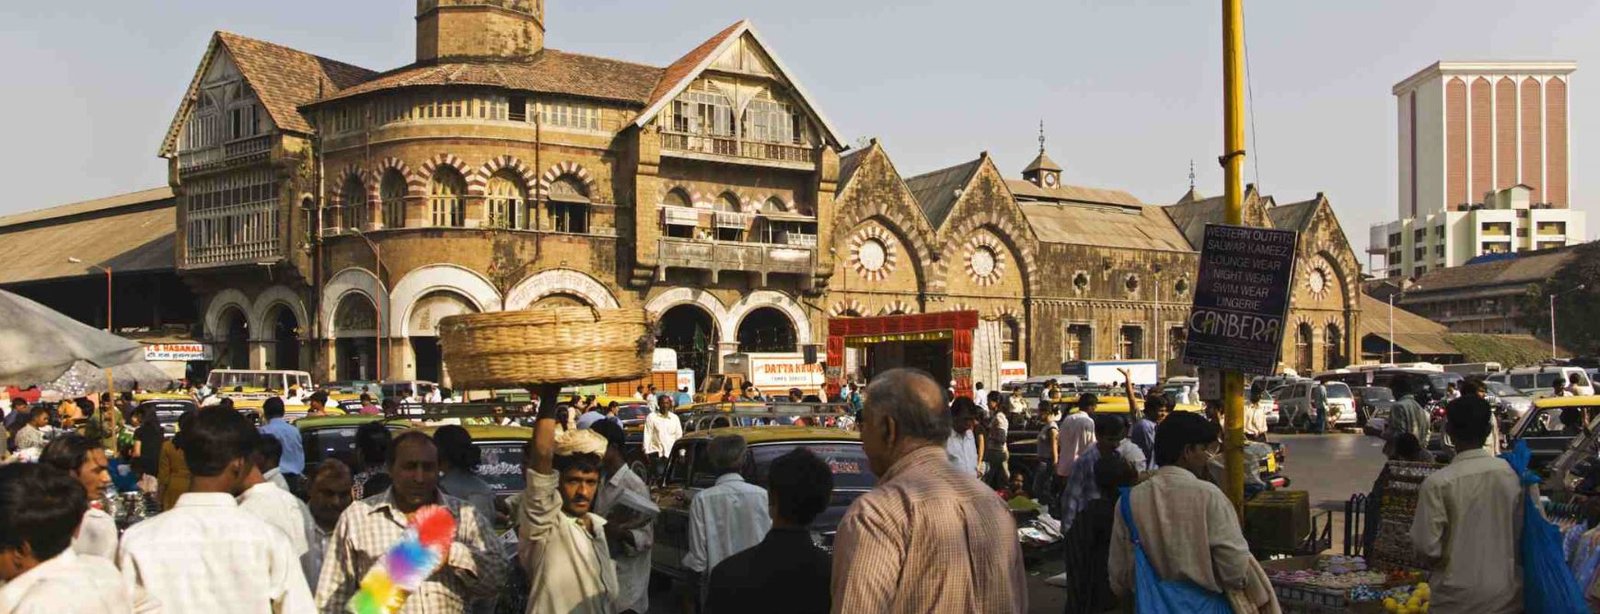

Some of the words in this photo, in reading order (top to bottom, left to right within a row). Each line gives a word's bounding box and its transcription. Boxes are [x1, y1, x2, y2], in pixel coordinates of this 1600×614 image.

[1206, 226, 1250, 239] WESTERN
[1252, 230, 1294, 243] OUTFITS
[1207, 239, 1247, 253] SALWAR
[1248, 244, 1289, 257] KAMEEZ
[1209, 254, 1250, 268] LOUNGE
[1252, 258, 1281, 270] WEAR
[1213, 269, 1242, 280] NIGHT
[1245, 272, 1273, 284] WEAR
[1213, 282, 1240, 294] SWIM
[1240, 285, 1269, 297] WEAR
[1216, 297, 1262, 310] LINGERIE
[1190, 310, 1280, 344] CANBERA
[764, 363, 793, 374] DATTA
